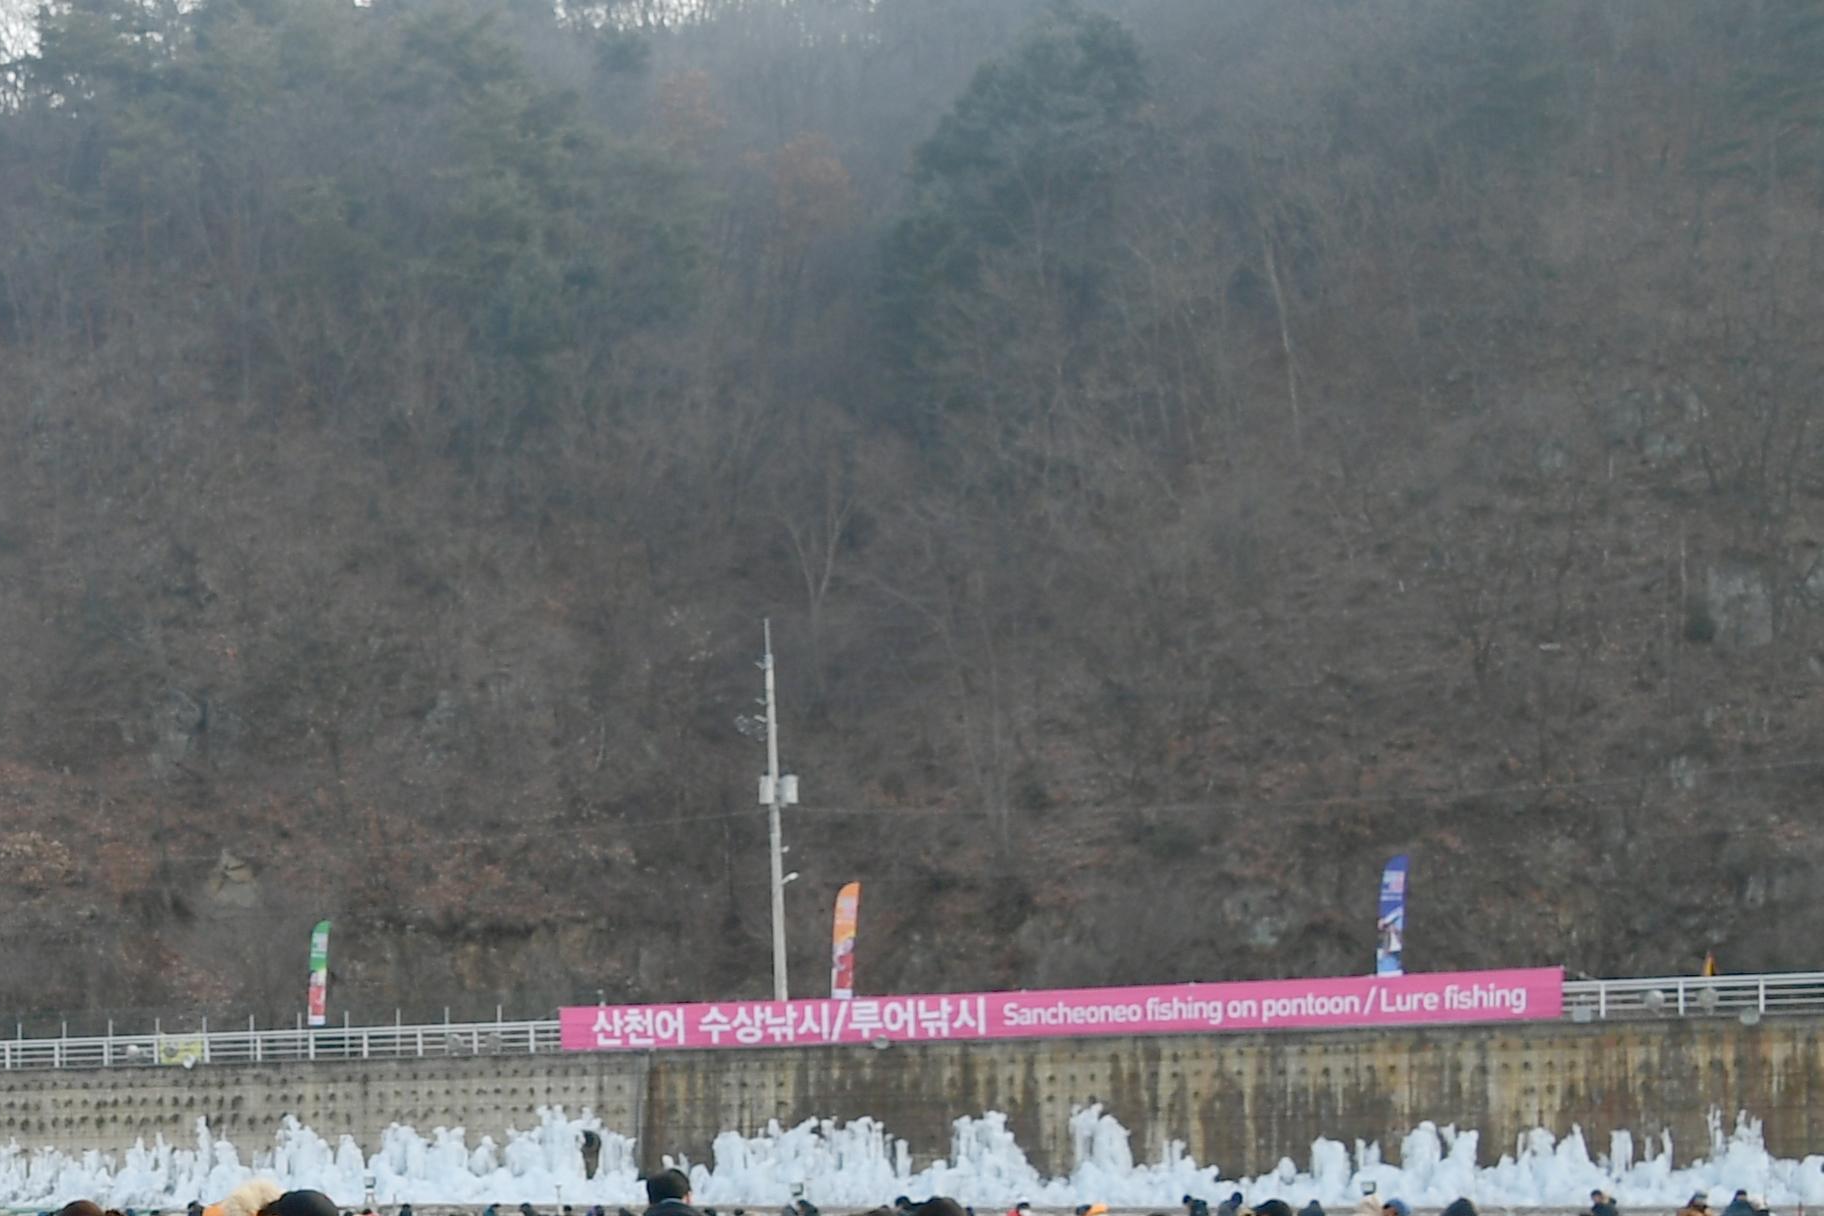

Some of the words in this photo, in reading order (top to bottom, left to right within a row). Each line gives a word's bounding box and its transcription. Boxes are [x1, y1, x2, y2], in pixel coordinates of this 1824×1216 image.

[592, 1007, 685, 1046] 산천어
[698, 995, 986, 1044] 수상낚시/루어낚시
[1003, 1001, 1140, 1026] Sancheoneo
[1146, 996, 1222, 1025] fishing
[1227, 999, 1257, 1018] on
[1261, 992, 1361, 1023] pontoon
[1380, 987, 1437, 1013] Lure
[1444, 983, 1527, 1014] fishing
